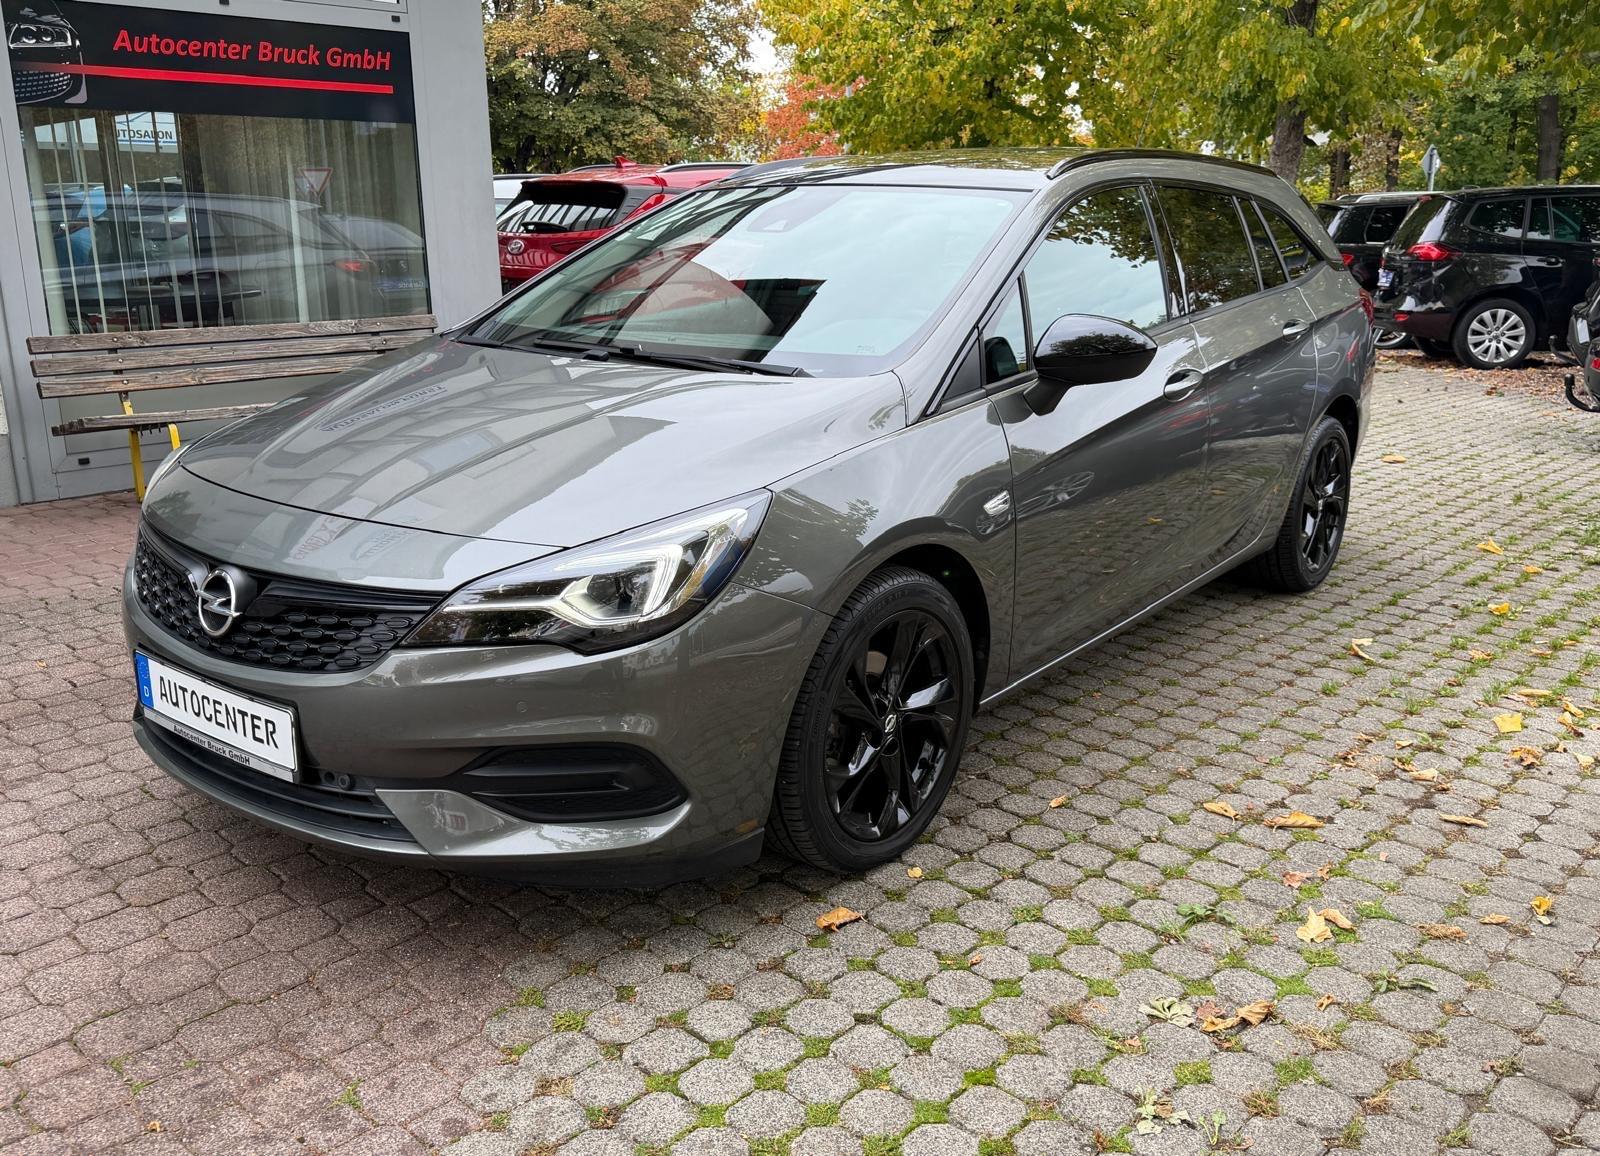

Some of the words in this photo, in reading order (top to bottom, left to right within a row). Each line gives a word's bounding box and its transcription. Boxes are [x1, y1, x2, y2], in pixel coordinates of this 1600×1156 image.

[113, 29, 252, 60] Autocenter
[258, 41, 321, 66] Bruck
[326, 47, 392, 70] GmbH
[144, 685, 150, 697] D
[159, 675, 279, 749] AUTOCENTER
[173, 724, 206, 746] Autocenter
[207, 740, 227, 756] Bruck
[228, 750, 251, 766] GmbH
